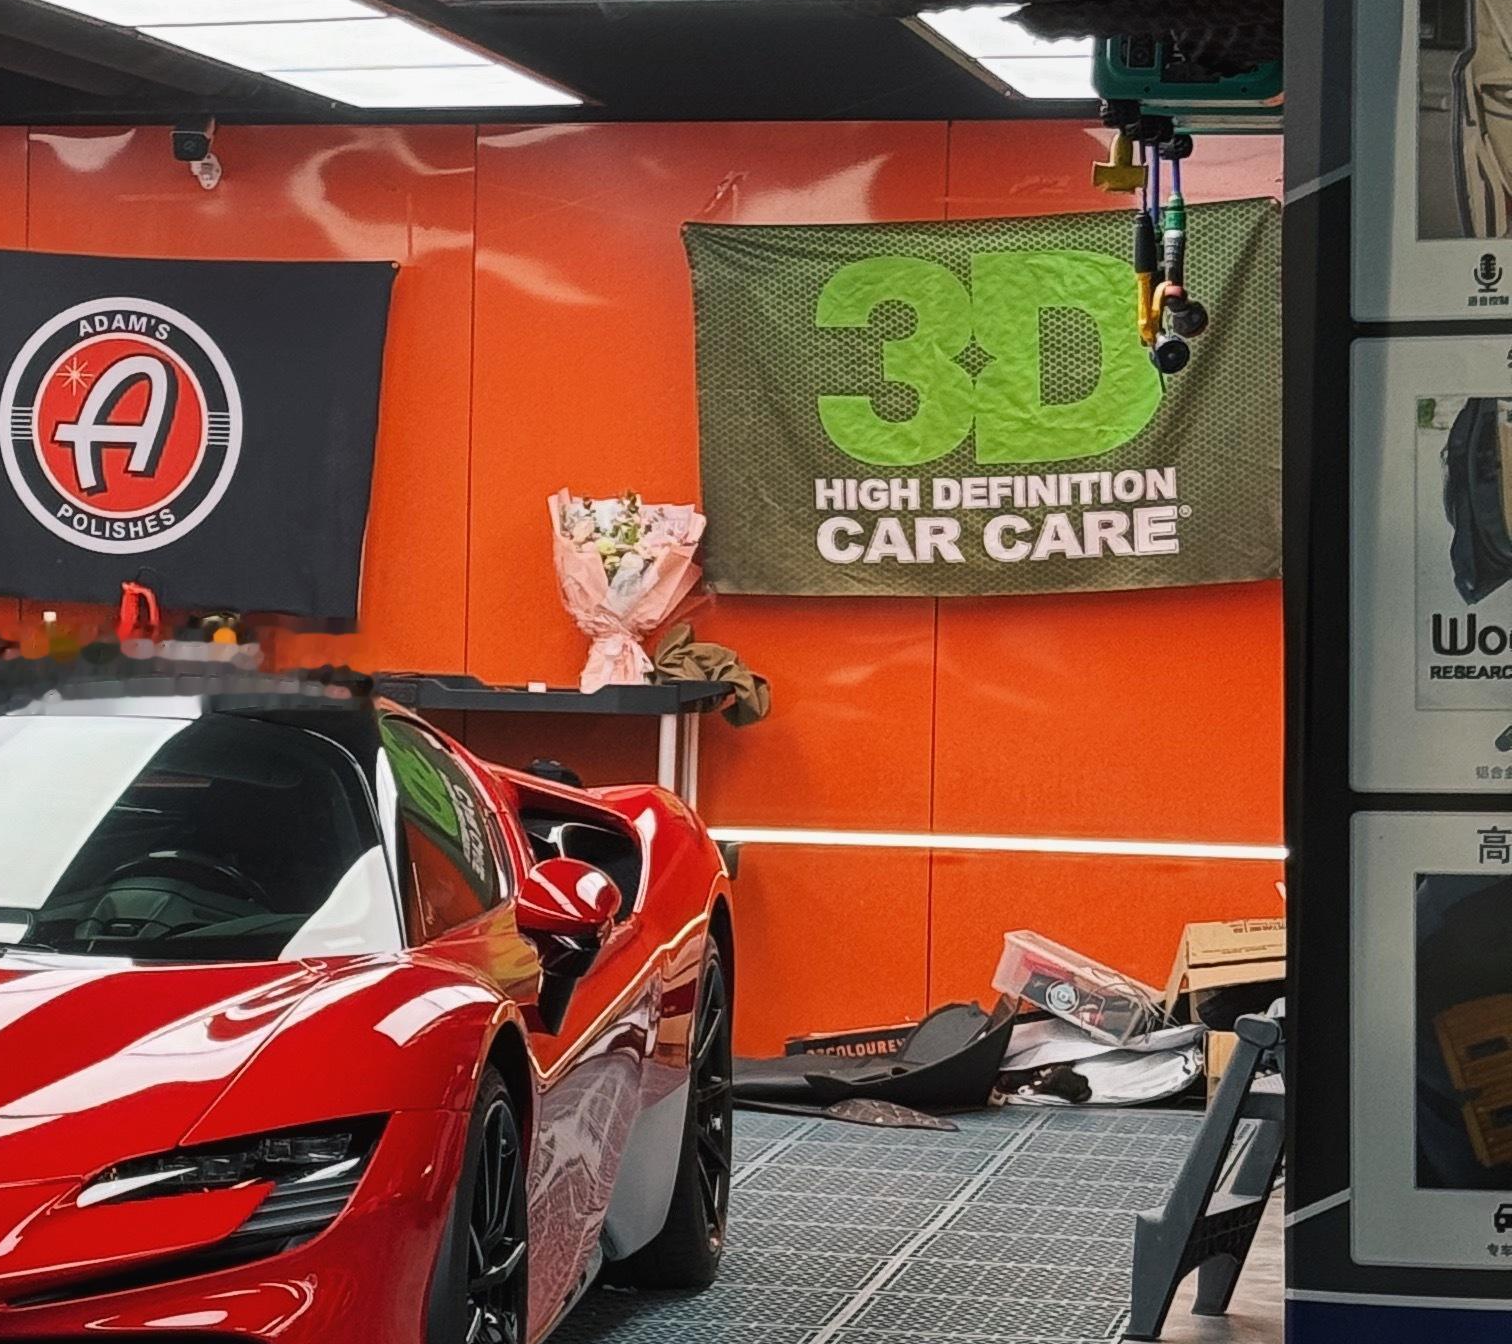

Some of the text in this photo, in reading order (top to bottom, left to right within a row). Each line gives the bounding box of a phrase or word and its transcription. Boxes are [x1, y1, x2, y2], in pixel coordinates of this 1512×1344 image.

[78, 314, 171, 341] ADAM'S
[816, 249, 1163, 467] 3D
[814, 467, 1177, 511] HIGH DEFINITION
[56, 503, 176, 539] POLISHES
[816, 517, 965, 564] CAR
[1432, 613, 1512, 656] Wo
[1477, 825, 1512, 865] 高
